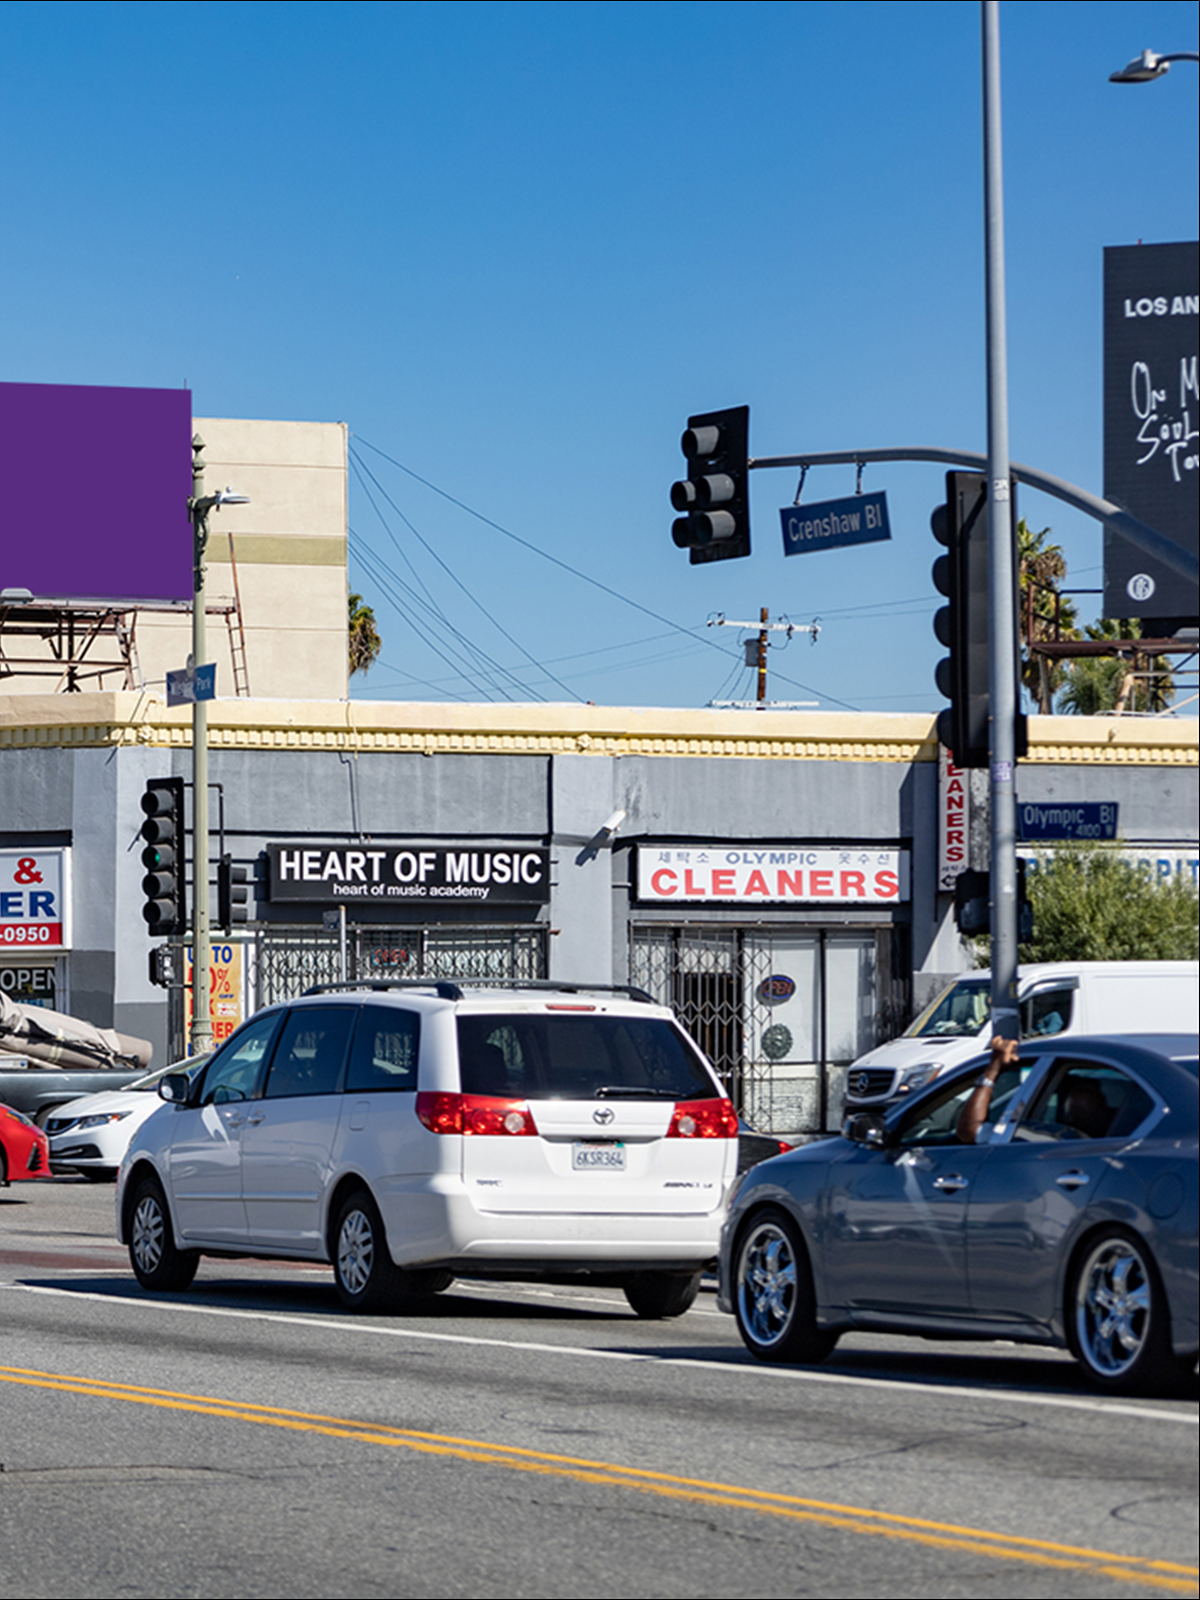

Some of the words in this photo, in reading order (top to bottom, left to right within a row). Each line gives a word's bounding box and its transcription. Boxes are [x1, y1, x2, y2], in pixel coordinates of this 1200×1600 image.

[1125, 297, 1168, 317] LOS
[788, 512, 860, 542] Crenshaw
[864, 503, 882, 529] Bl
[1023, 805, 1085, 828] Olympic
[1100, 805, 1115, 824] Bl
[1076, 824, 1101, 837] 4100
[1106, 824, 1113, 836] W
[279, 850, 386, 882] HEART
[394, 852, 436, 883] OF
[446, 852, 542, 885] MUSIC
[657, 851, 709, 864] 세탁소
[725, 852, 818, 865] OLYMPIC
[13, 857, 44, 885] &
[333, 883, 368, 896] heart
[370, 884, 385, 896] of
[387, 885, 427, 897] music
[429, 885, 490, 900] academy
[650, 867, 899, 898] CLEANERS
[211, 945, 233, 964] TO
